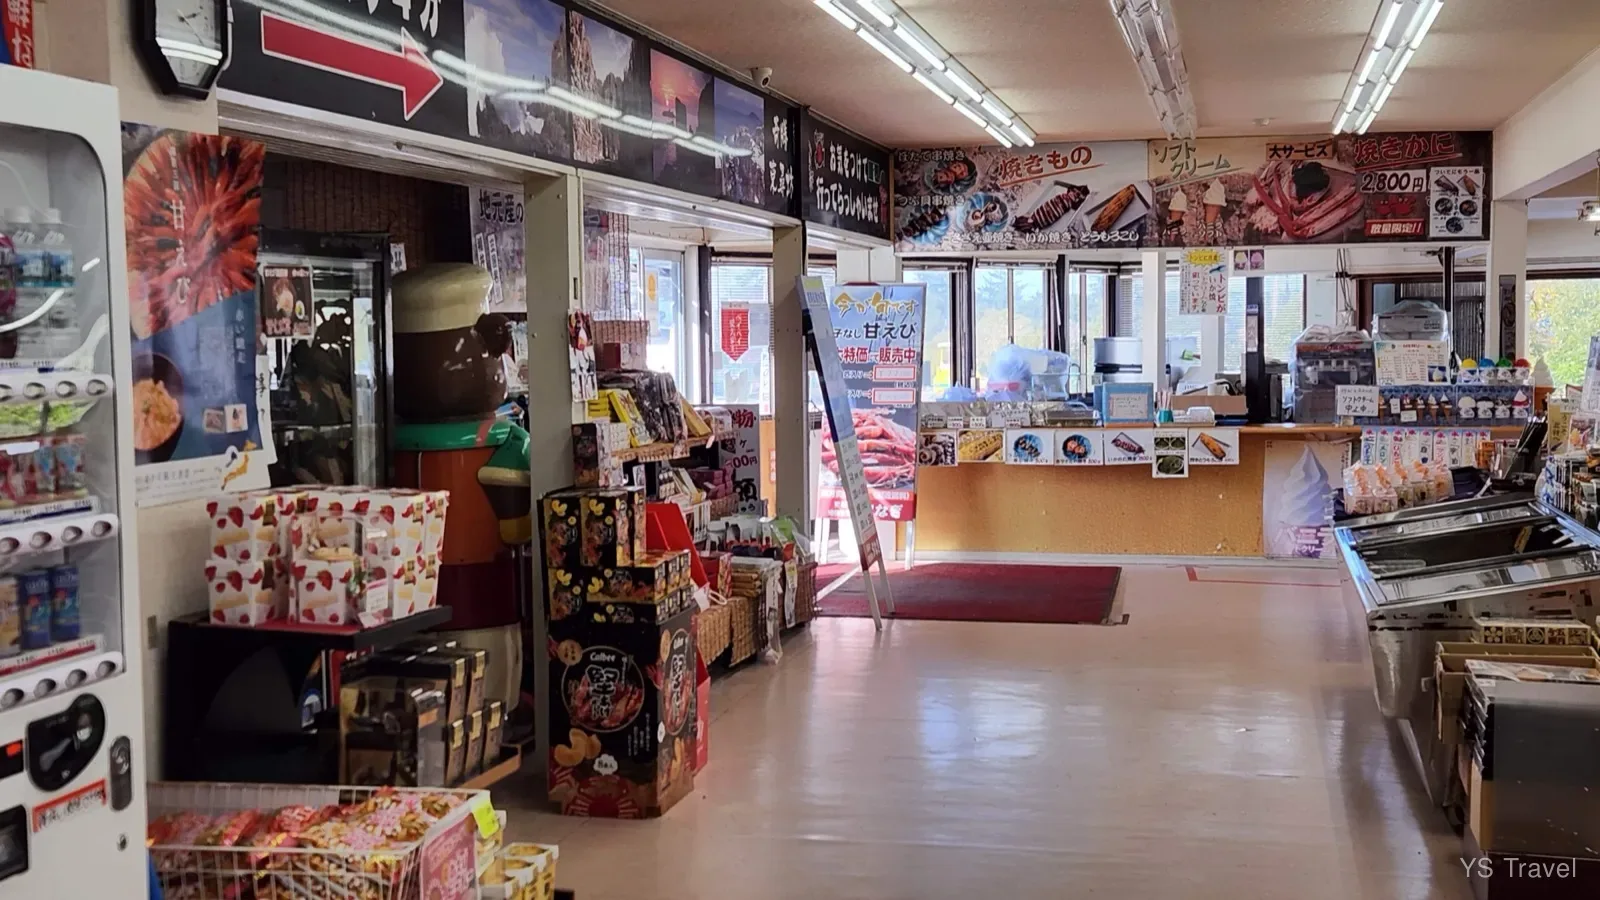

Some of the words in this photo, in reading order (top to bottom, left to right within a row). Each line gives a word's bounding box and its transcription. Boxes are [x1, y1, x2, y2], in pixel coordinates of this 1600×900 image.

[1154, 141, 1196, 163] ソフト
[1269, 144, 1328, 158] 大サービス
[1354, 133, 1455, 163] 焼きかに
[829, 141, 868, 183] お気をつけて
[1000, 145, 1092, 181] 焼きもの
[1170, 154, 1231, 179] クリーム
[1361, 172, 1424, 192] 2,800円
[479, 189, 523, 223] 地元産の
[816, 176, 879, 224] 行ってらっしゃいませ
[1025, 230, 1071, 243] いか焼き
[1080, 230, 1139, 243] とうもろこし
[863, 322, 917, 339] 甘えび
[590, 652, 616, 662] Calbee
